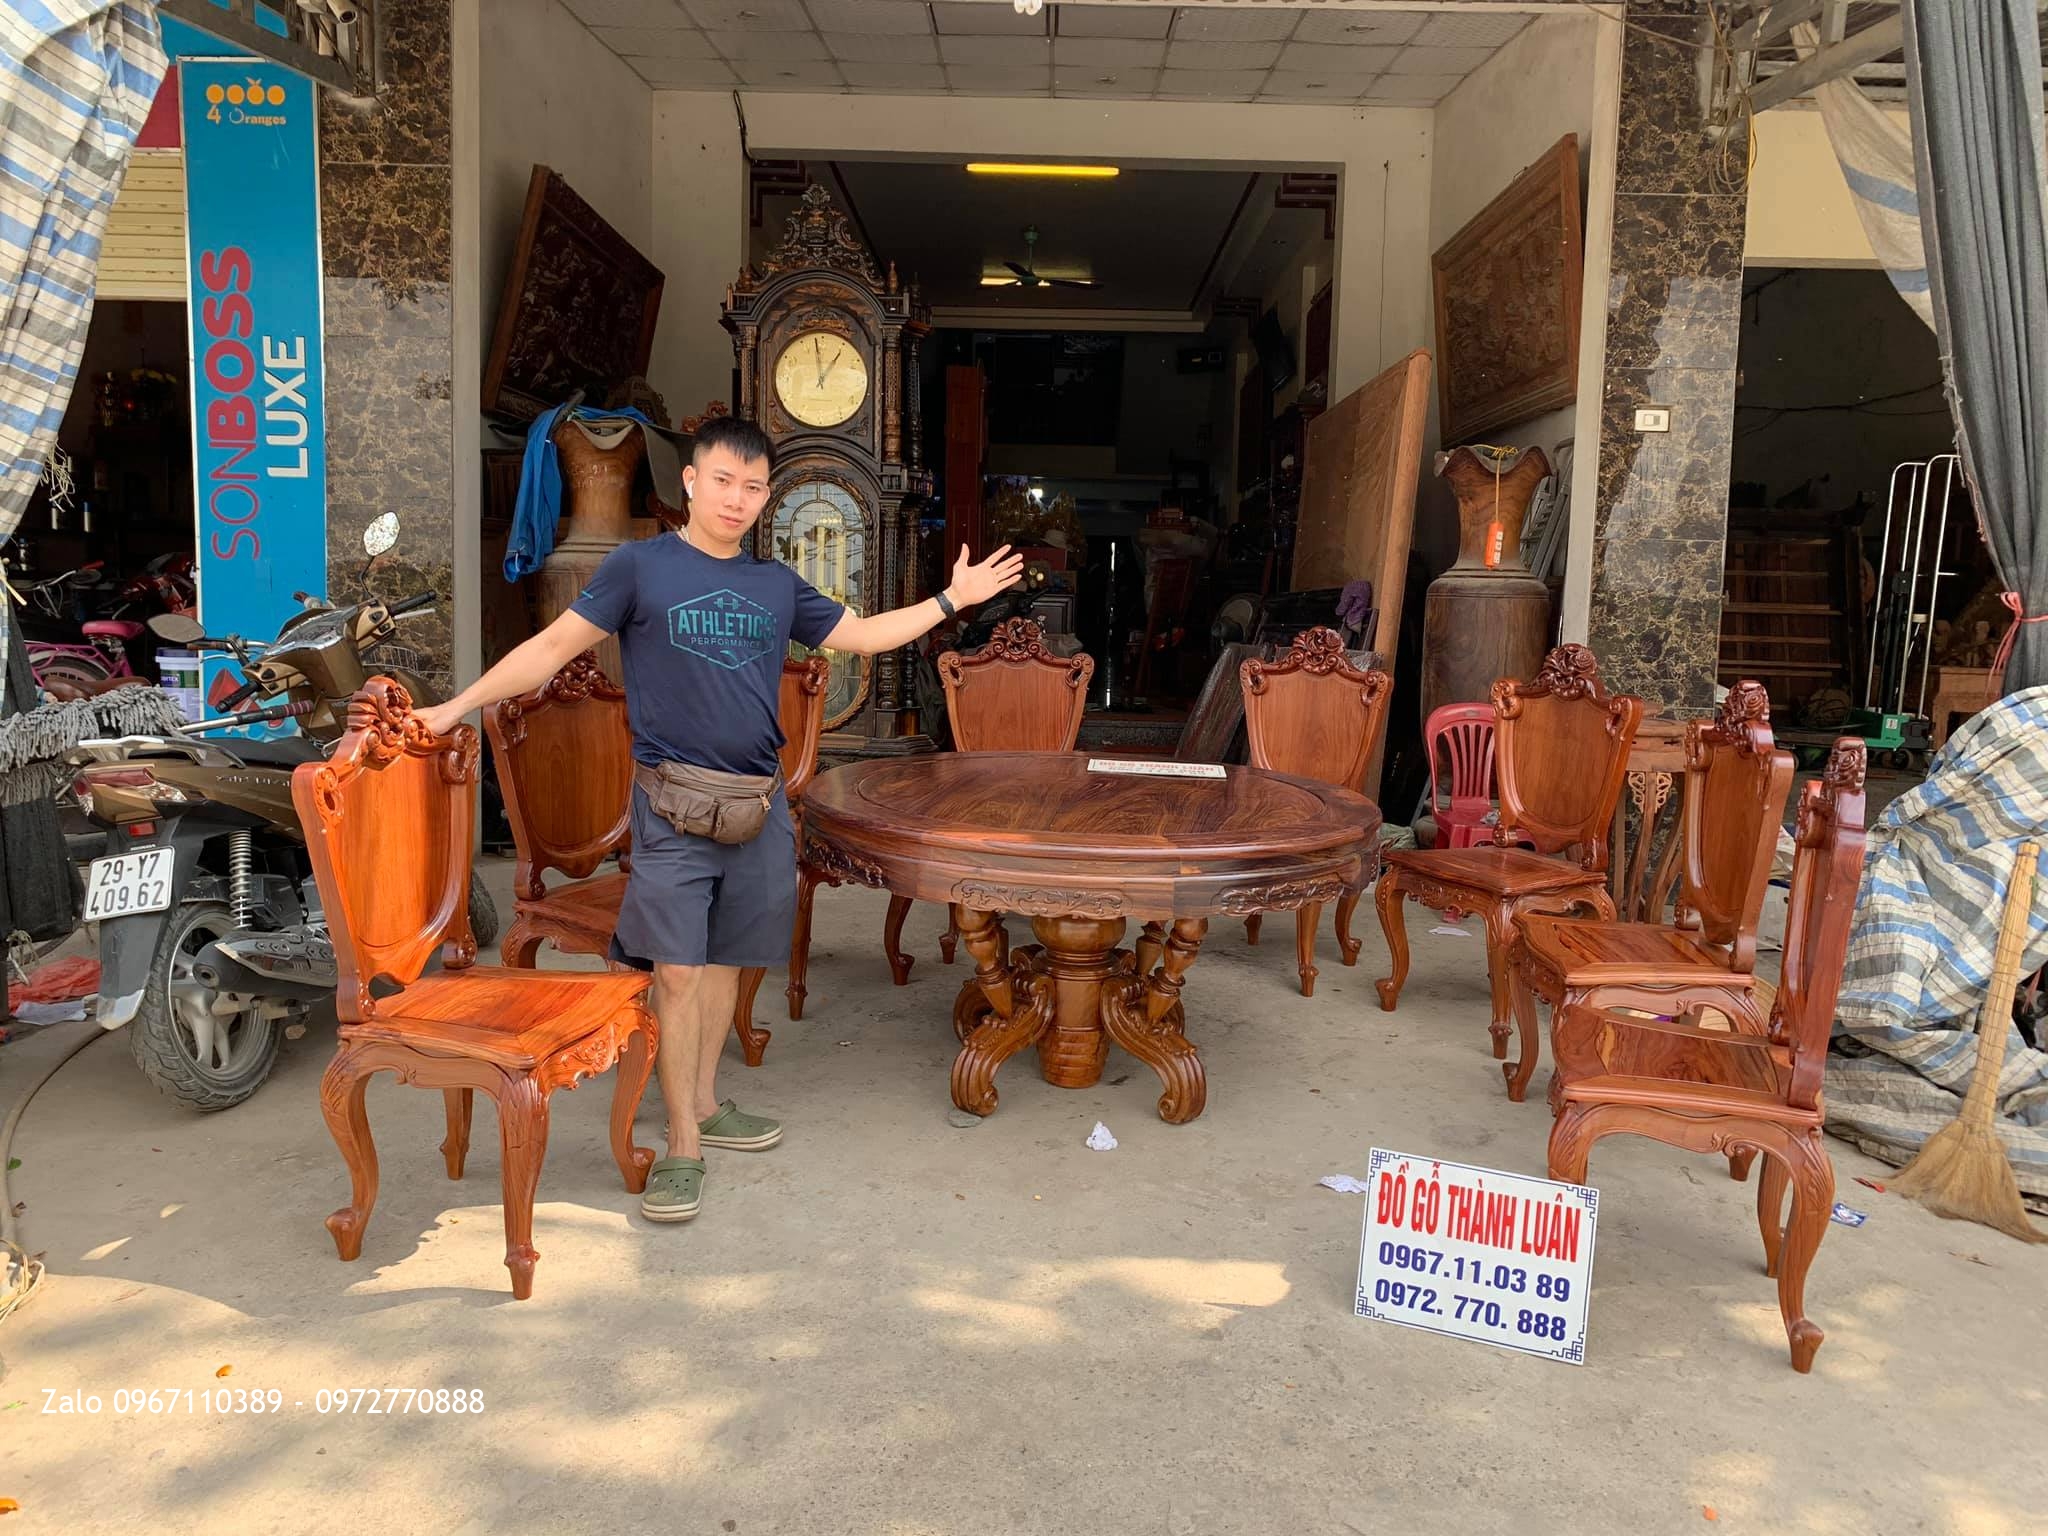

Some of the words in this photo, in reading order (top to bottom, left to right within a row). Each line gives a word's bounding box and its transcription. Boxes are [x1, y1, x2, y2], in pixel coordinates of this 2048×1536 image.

[207, 104, 221, 125] 4
[229, 107, 287, 127] Oranges
[263, 335, 309, 479] LUXE
[89, 880, 164, 915] 409.62
[100, 852, 161, 887] 29-Y7
[1376, 1161, 1410, 1229] ĐỒ
[1410, 1161, 1441, 1235] GỖ
[1446, 1179, 1518, 1251] THÀNH
[1520, 1192, 1581, 1263] LUÂN
[1378, 1241, 1527, 1293] 0967.11.03
[1535, 1273, 1571, 1303] 89
[1375, 1278, 1443, 1315] 0972.
[1453, 1294, 1507, 1329] 770.
[1516, 1308, 1567, 1342] 888
